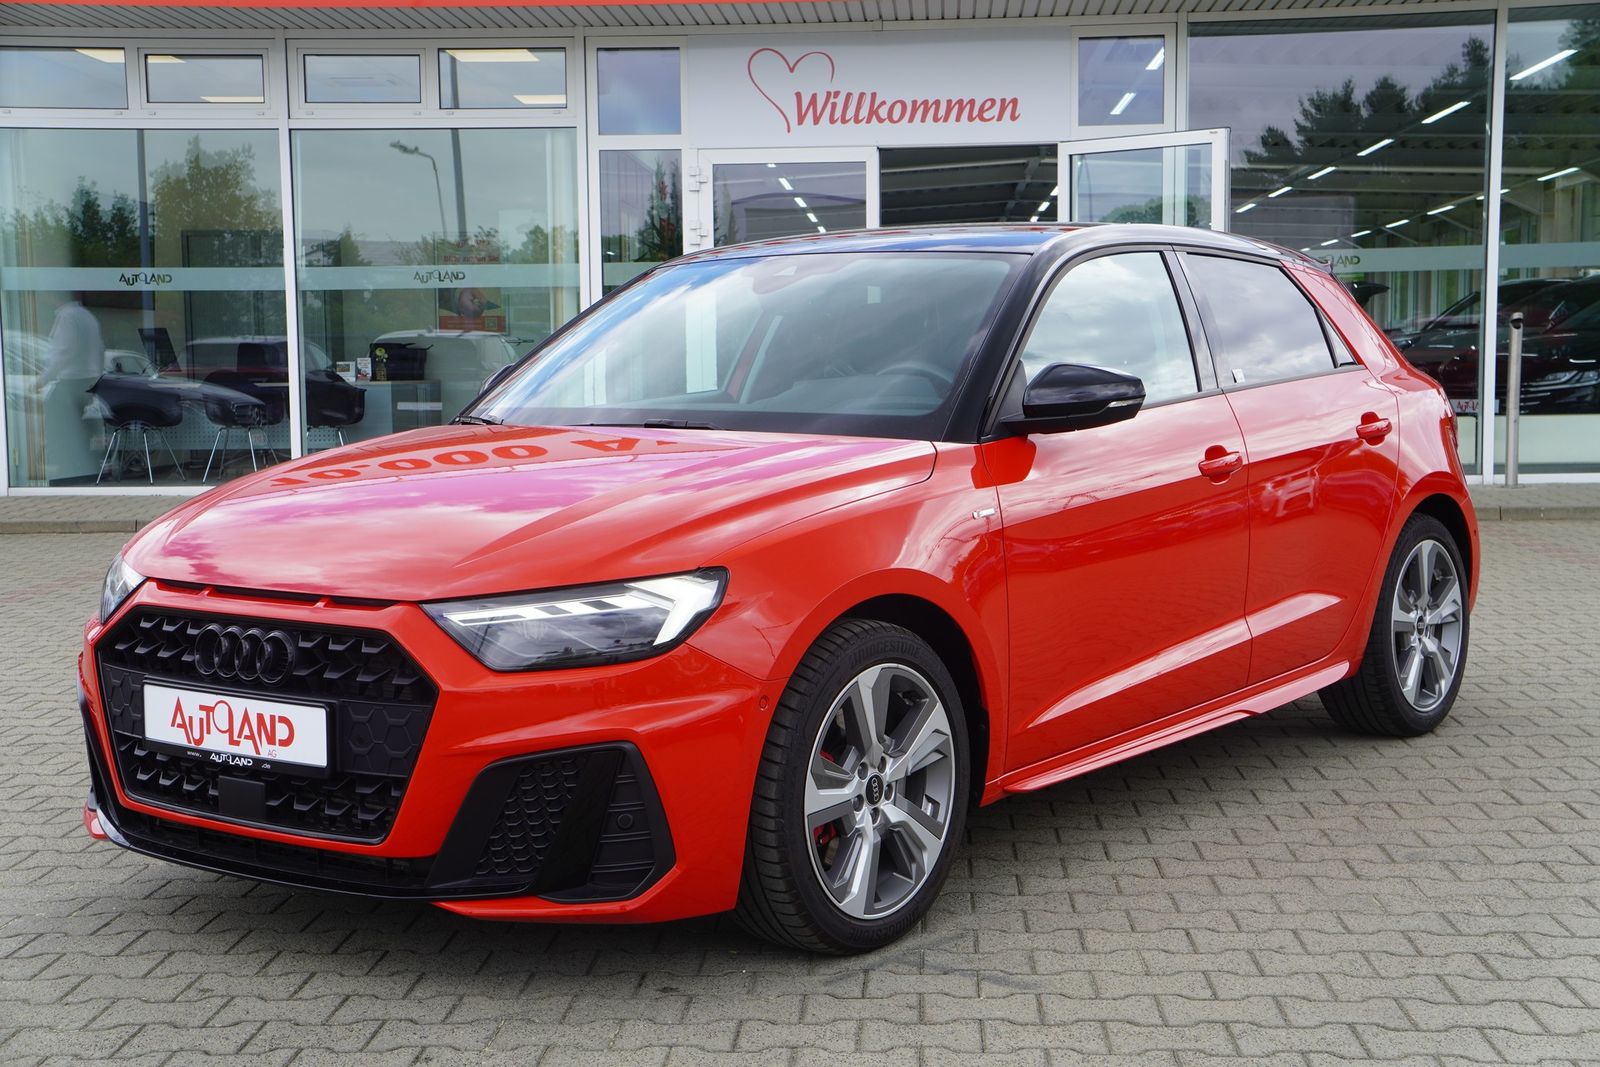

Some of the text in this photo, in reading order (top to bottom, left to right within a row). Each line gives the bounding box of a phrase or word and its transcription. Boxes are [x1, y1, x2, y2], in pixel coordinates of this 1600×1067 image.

[794, 90, 1021, 126] Willkommen
[118, 271, 173, 286] AUTOLAND
[413, 269, 466, 284] AUTOLAND
[171, 696, 295, 755] AUTOLAND
[210, 753, 253, 767] AUTOLAND
